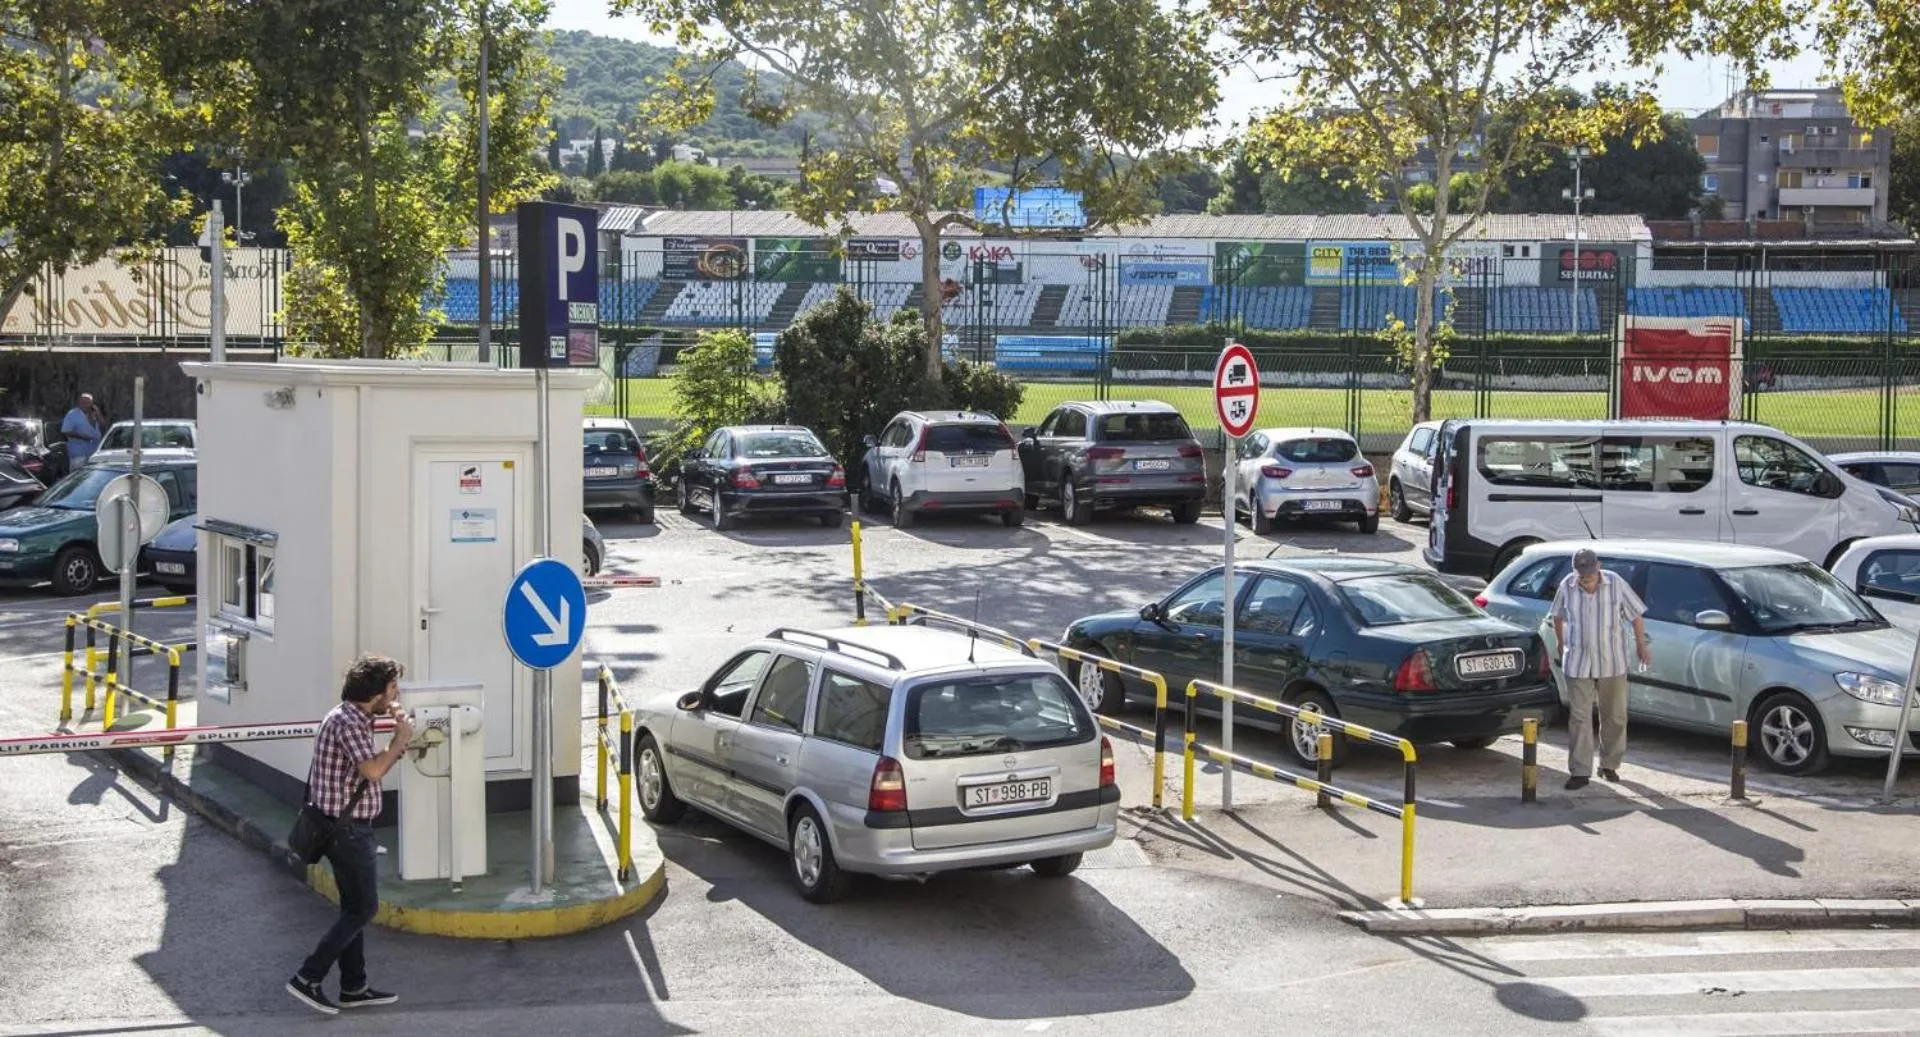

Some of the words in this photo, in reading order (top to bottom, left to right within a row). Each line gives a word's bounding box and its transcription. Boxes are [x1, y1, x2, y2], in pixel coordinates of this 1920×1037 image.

[557, 216, 586, 301] P
[1312, 247, 1341, 257] CITY
[197, 731, 240, 740] SPLIT
[246, 727, 314, 738] PARKING
[29, 740, 101, 751] PARKING
[975, 786, 992, 804] ST
[1001, 781, 1049, 801] 998-PB
